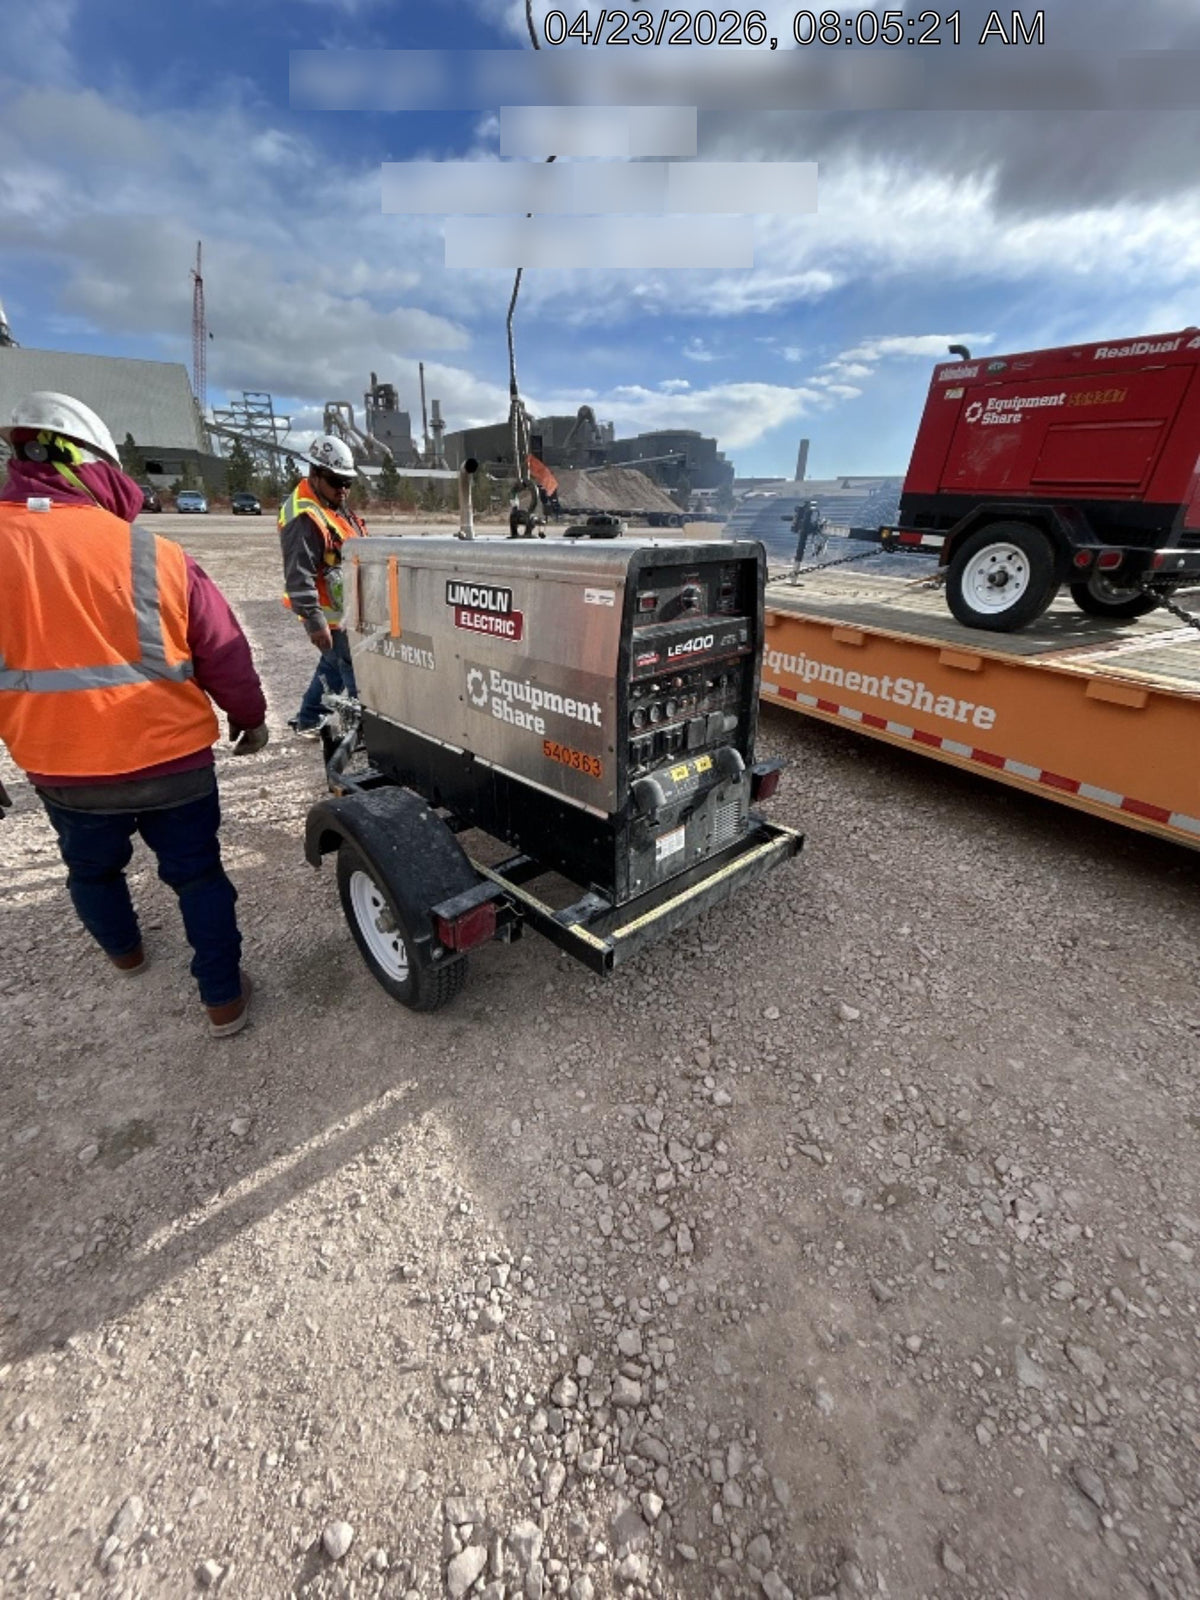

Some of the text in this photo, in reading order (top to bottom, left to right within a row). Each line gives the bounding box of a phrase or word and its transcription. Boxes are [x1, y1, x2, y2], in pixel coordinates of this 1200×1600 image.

[1094, 337, 1182, 360] RealDual
[986, 392, 1067, 411] Equipment
[981, 412, 1022, 425] Share
[447, 584, 509, 613] LINCOLN
[460, 611, 515, 636] ELECTRIC
[667, 634, 714, 657] LE400
[489, 669, 602, 727] Equipment
[492, 696, 546, 735] Share
[543, 740, 602, 778] 540363
